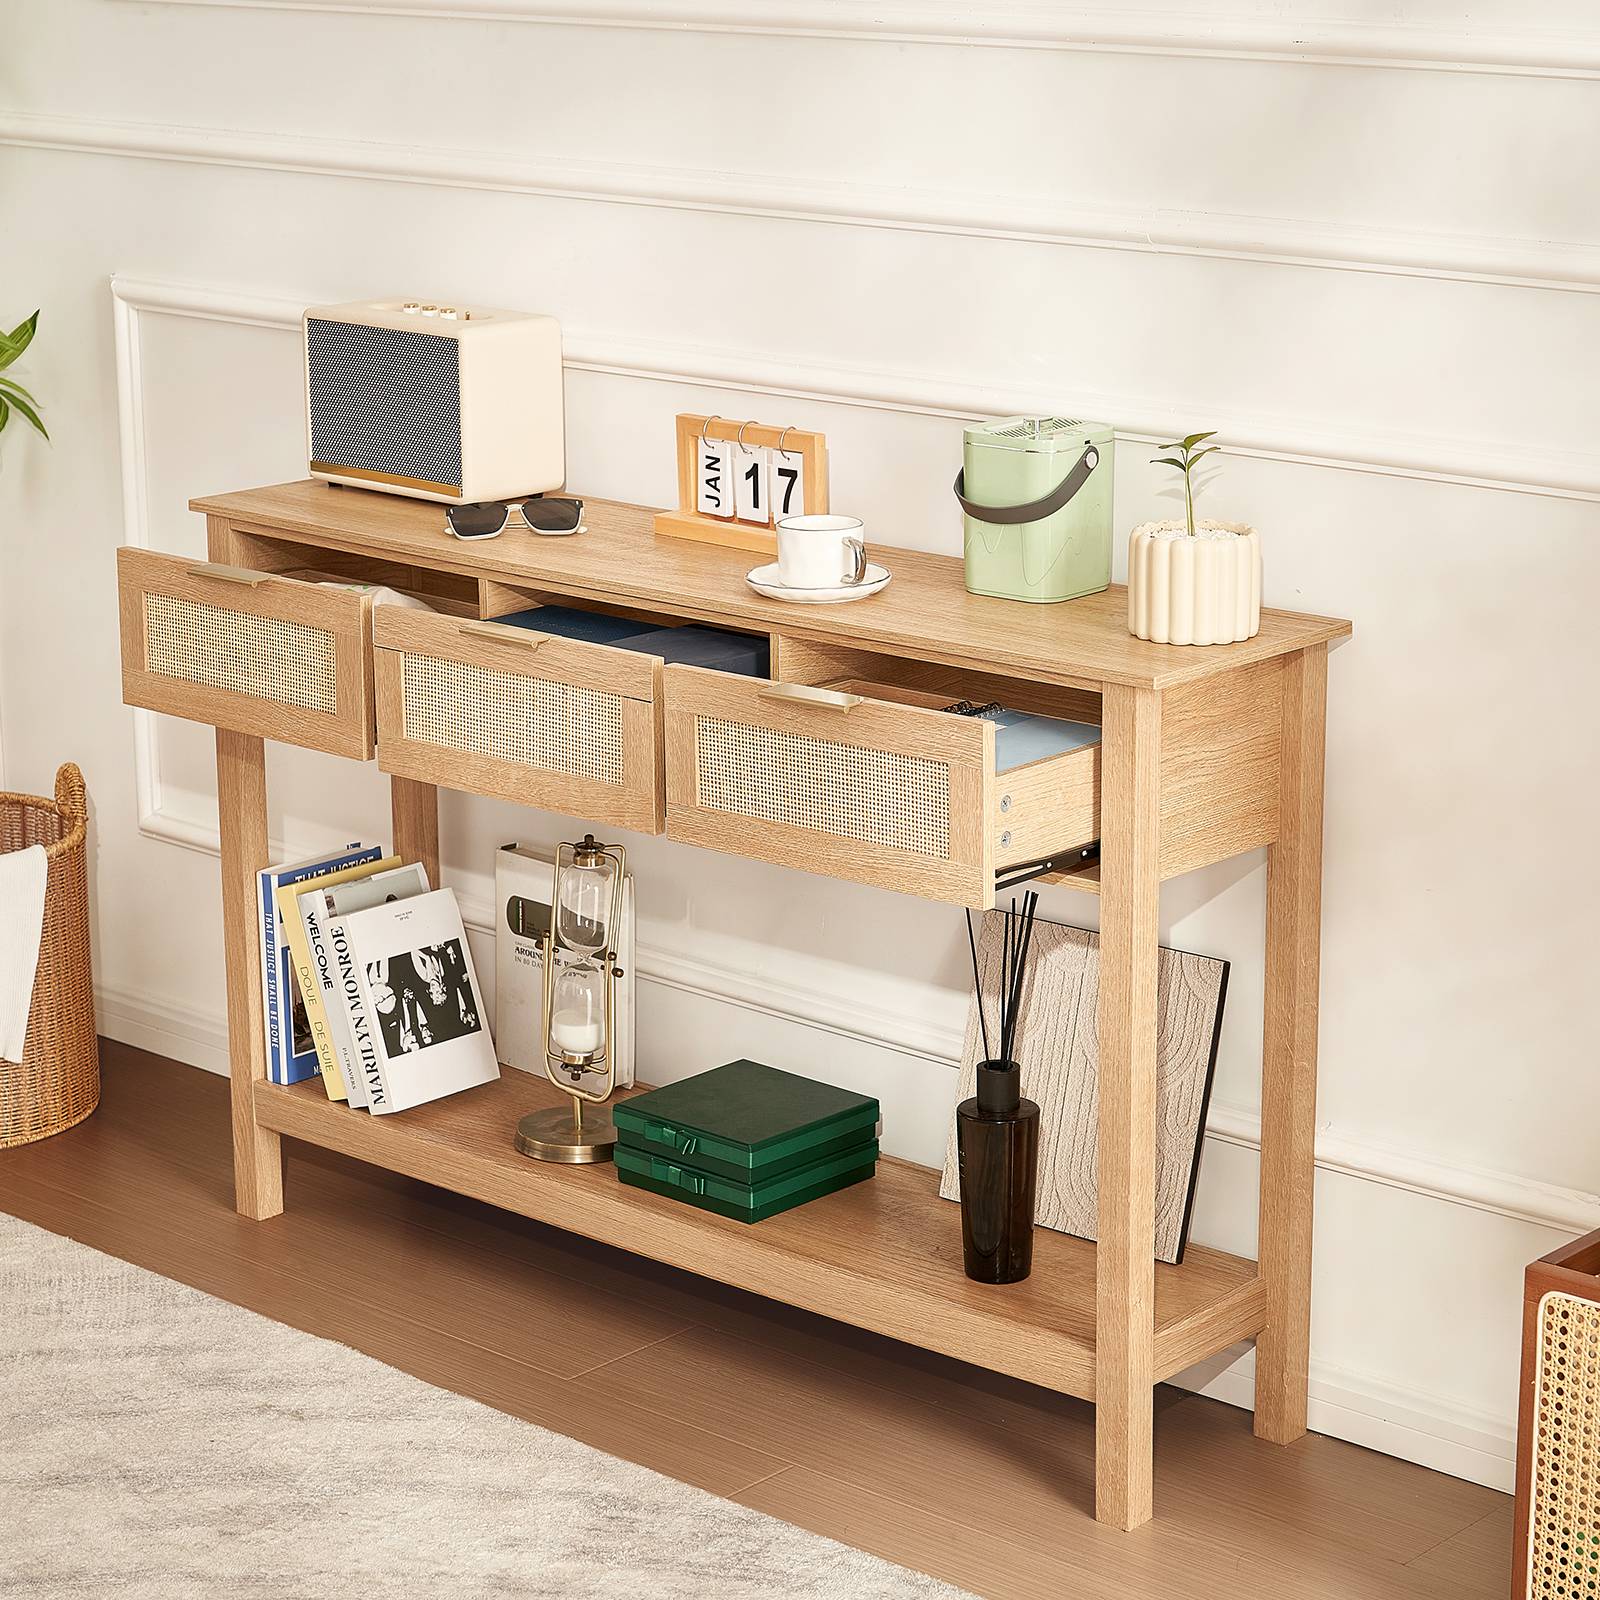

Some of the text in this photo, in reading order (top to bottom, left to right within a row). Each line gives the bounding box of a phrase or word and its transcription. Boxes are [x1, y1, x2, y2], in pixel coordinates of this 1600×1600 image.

[705, 455, 721, 508] JAN
[265, 913, 279, 1049] THAT JUSTICE SHALL BE DONE
[306, 911, 334, 990] WELCOME
[515, 946, 544, 962] AROUN
[300, 966, 334, 1073] DOUE DE SUIE
[330, 926, 386, 1106] MARILYN MONROE
